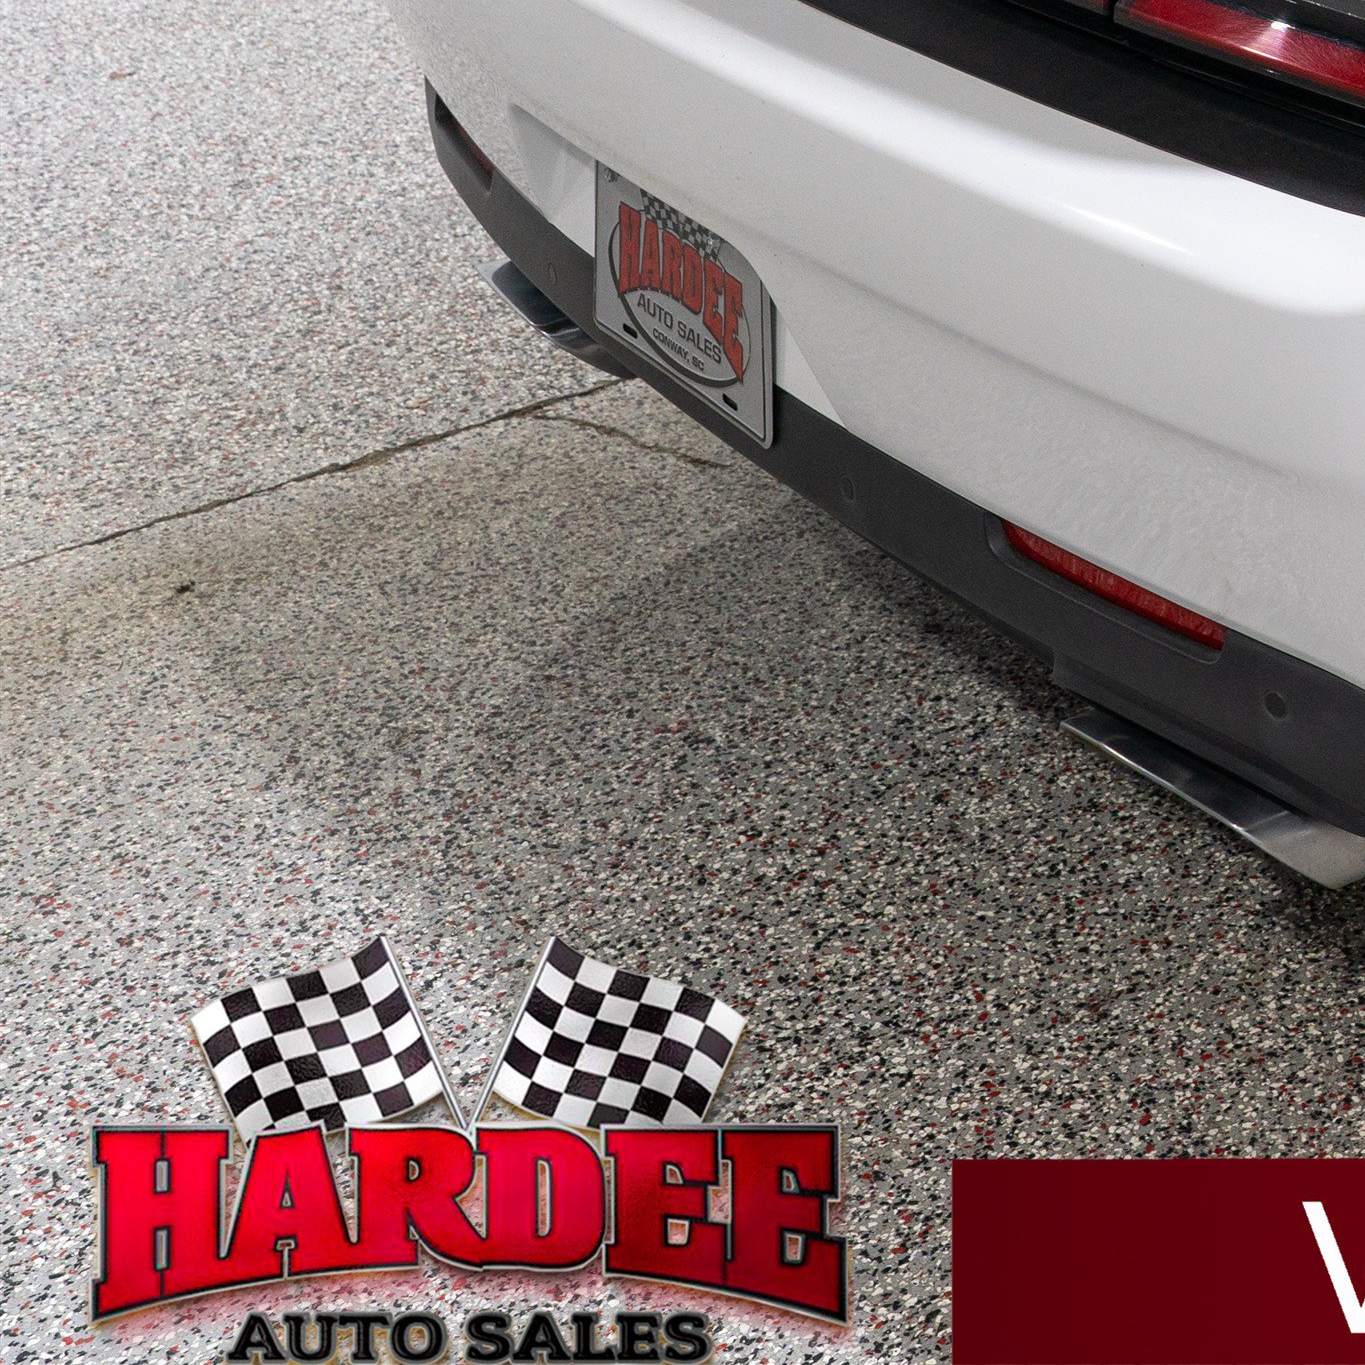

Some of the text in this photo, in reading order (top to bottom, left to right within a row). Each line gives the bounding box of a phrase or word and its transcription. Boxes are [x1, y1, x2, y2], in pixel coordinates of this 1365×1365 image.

[617, 200, 744, 385] HARDEE
[637, 293, 722, 364] AUTO SALES
[653, 328, 705, 372] CONWAY, SC
